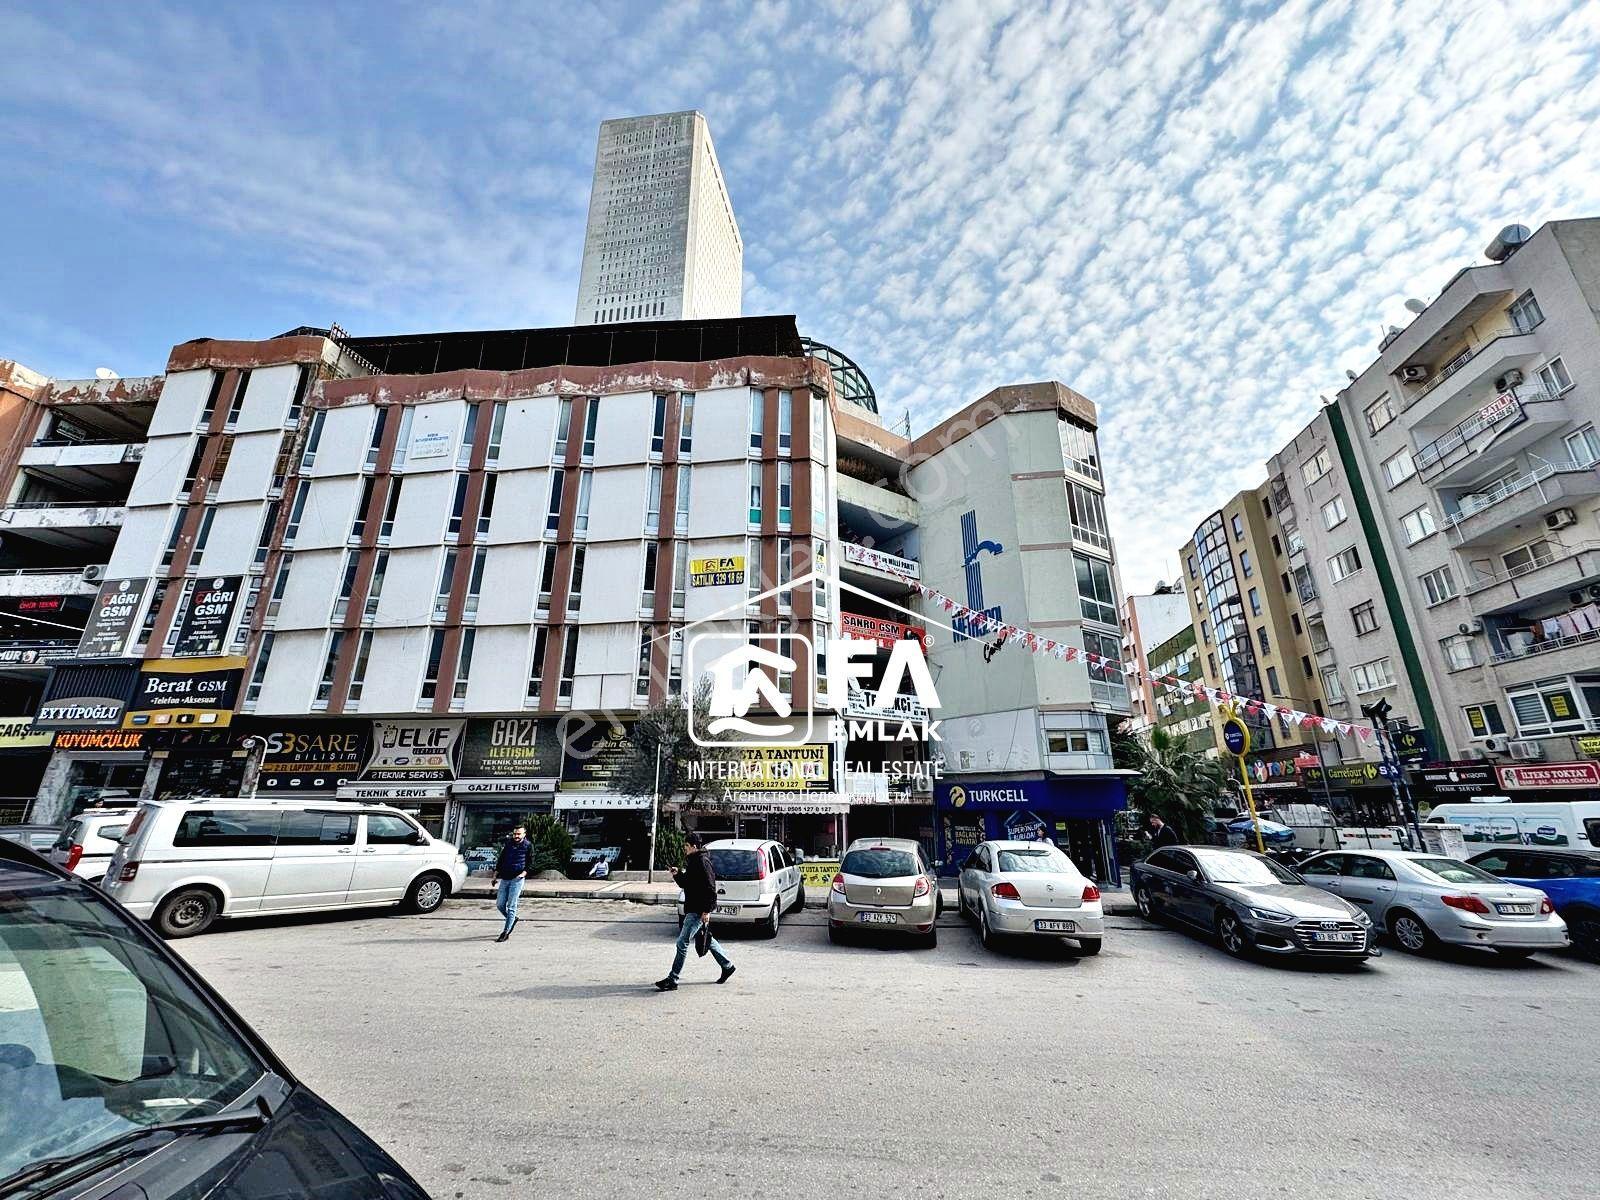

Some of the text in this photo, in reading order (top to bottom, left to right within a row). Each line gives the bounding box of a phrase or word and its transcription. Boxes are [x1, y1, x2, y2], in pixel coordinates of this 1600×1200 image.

[720, 558, 735, 568] FA
[100, 605, 132, 618] GSM
[194, 604, 228, 616] GSM
[843, 615, 876, 630] SANRO
[879, 622, 900, 635] GSM
[144, 677, 228, 694] Berat GSM
[152, 695, 217, 705] Telefon Aksesuar
[39, 704, 119, 720] EYYÜPOĞLU
[55, 733, 143, 748] KUYUMCULUK
[295, 734, 358, 753] SARE
[968, 789, 1029, 803] TURKCELL
